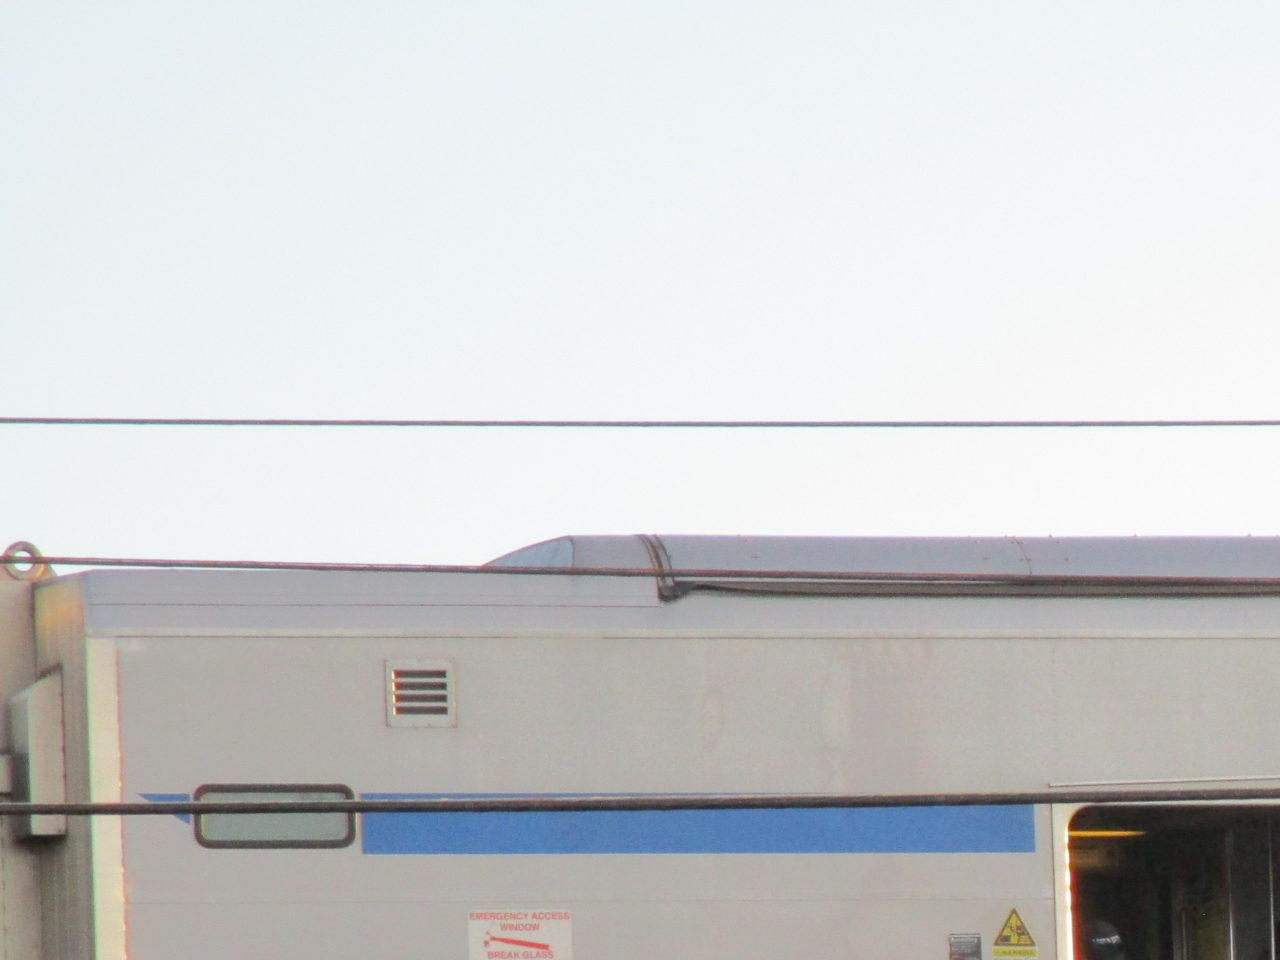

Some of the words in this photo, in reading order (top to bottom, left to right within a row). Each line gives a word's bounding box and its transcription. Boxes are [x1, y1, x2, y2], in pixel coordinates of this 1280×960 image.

[469, 912, 528, 920] EMERGENCY
[531, 912, 570, 920] ACCESS
[500, 923, 540, 931] WINDOW
[488, 951, 520, 959] BREAK
[522, 951, 554, 959] GLASS
